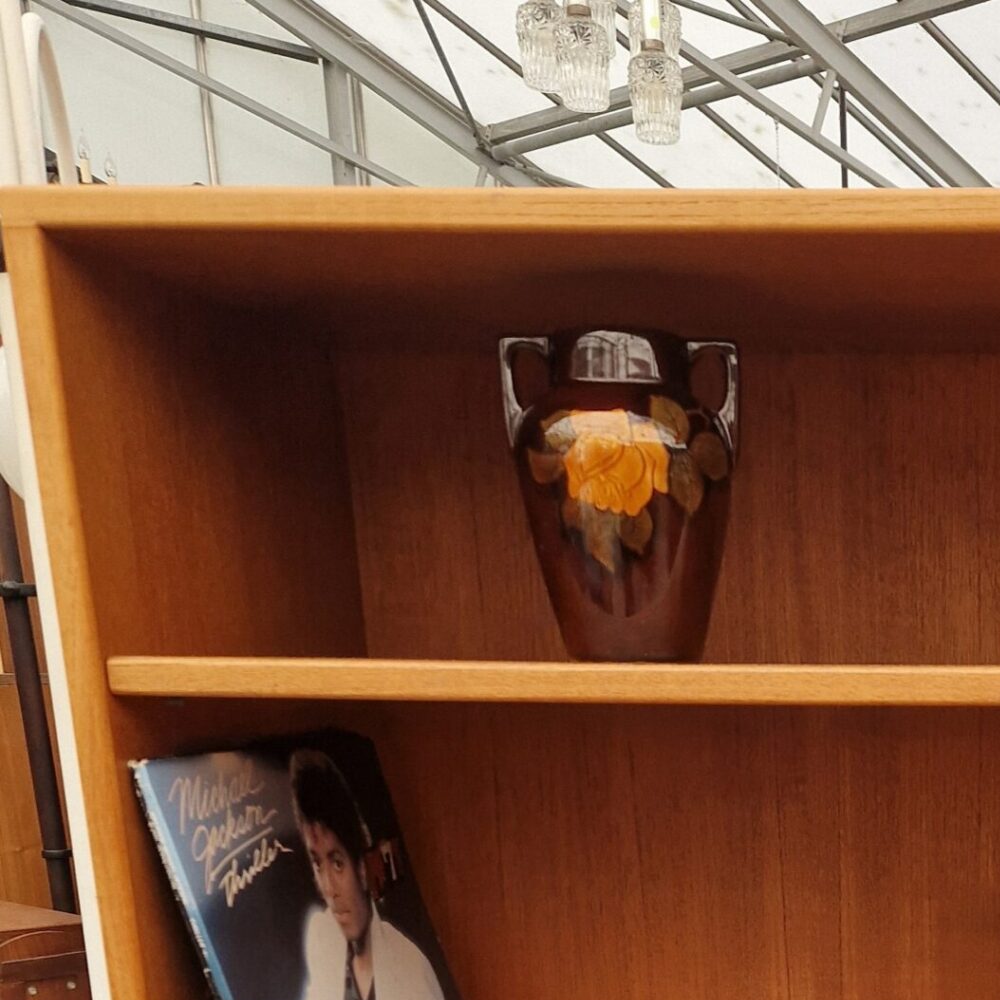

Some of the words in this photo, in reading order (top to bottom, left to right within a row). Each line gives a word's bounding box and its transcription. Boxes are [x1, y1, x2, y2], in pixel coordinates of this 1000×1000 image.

[168, 768, 264, 834] Michael
[192, 803, 279, 895] Jackson
[218, 838, 294, 908] Thriller
